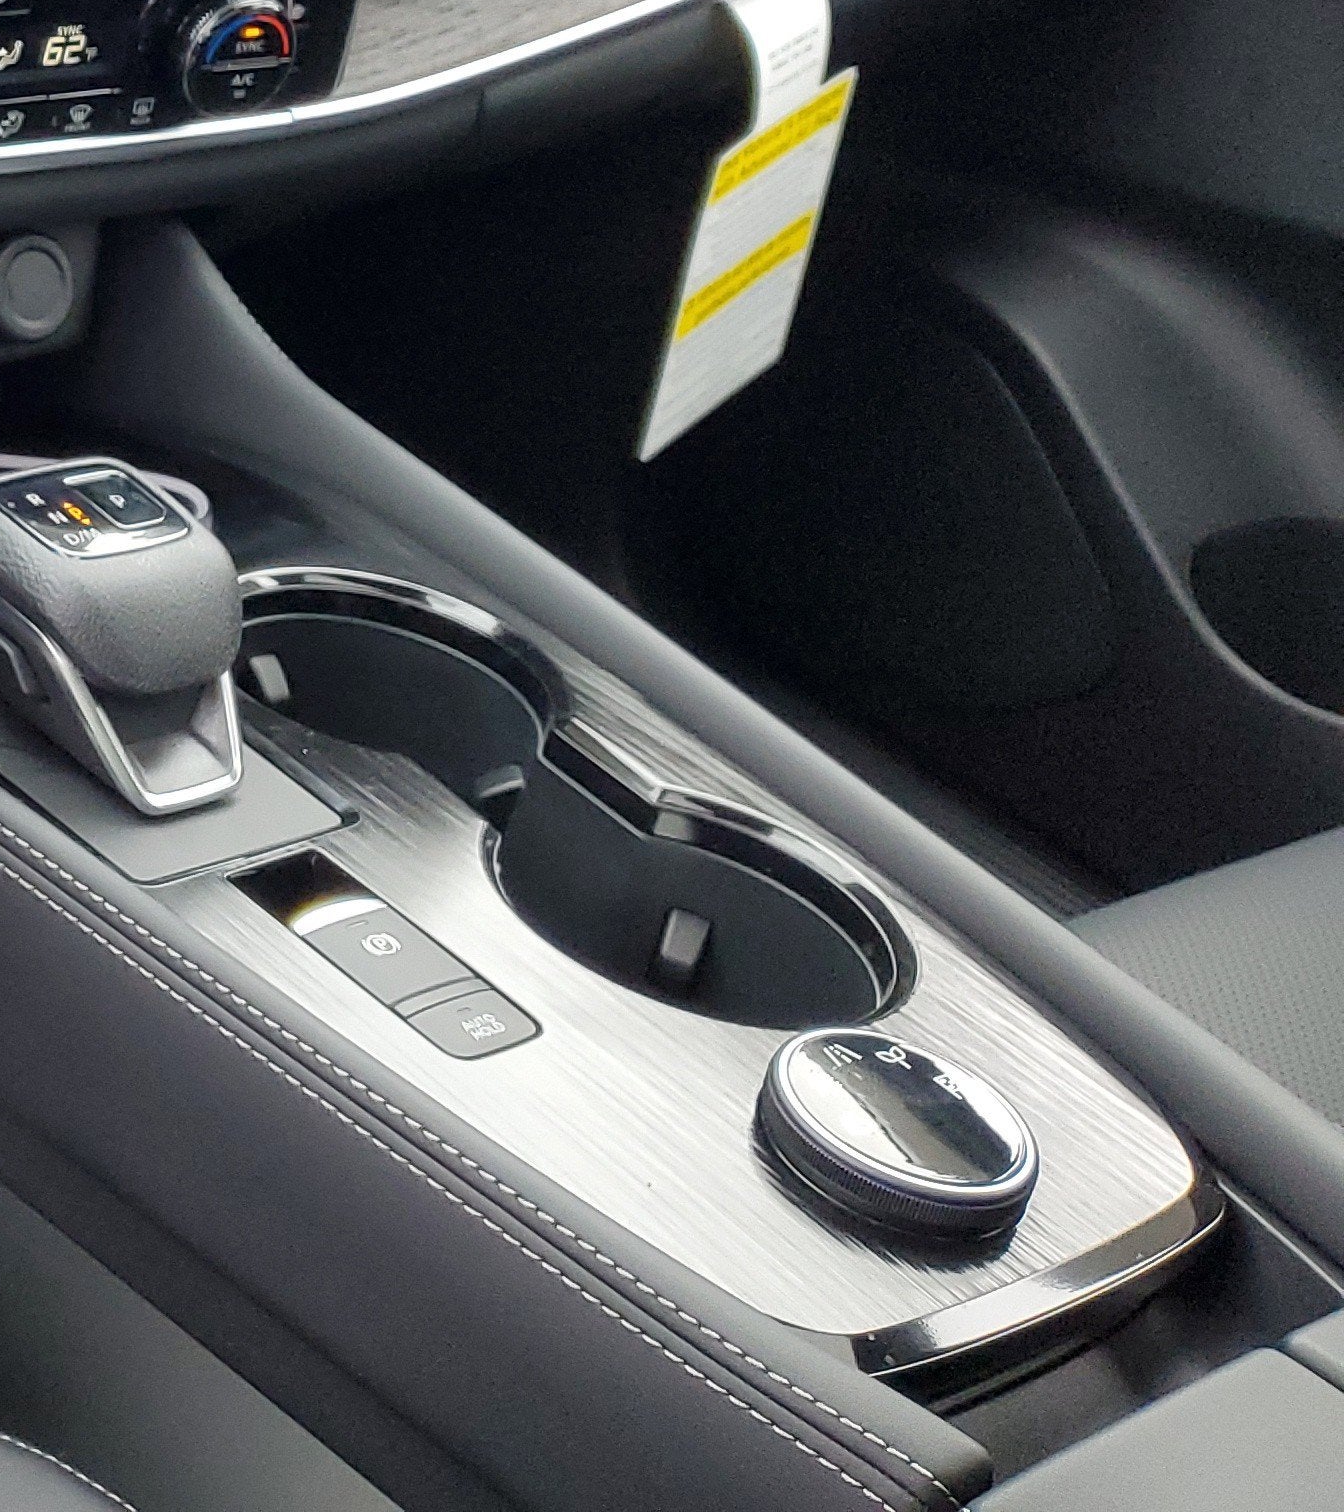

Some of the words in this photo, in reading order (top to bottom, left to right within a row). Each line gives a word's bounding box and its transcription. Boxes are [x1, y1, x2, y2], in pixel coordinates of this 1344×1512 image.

[57, 24, 85, 37] SYNC
[229, 72, 256, 87] A/C
[25, 492, 47, 507] R
[108, 493, 126, 509] P
[461, 1013, 496, 1034] AUTO
[470, 1021, 506, 1042] HOLD
